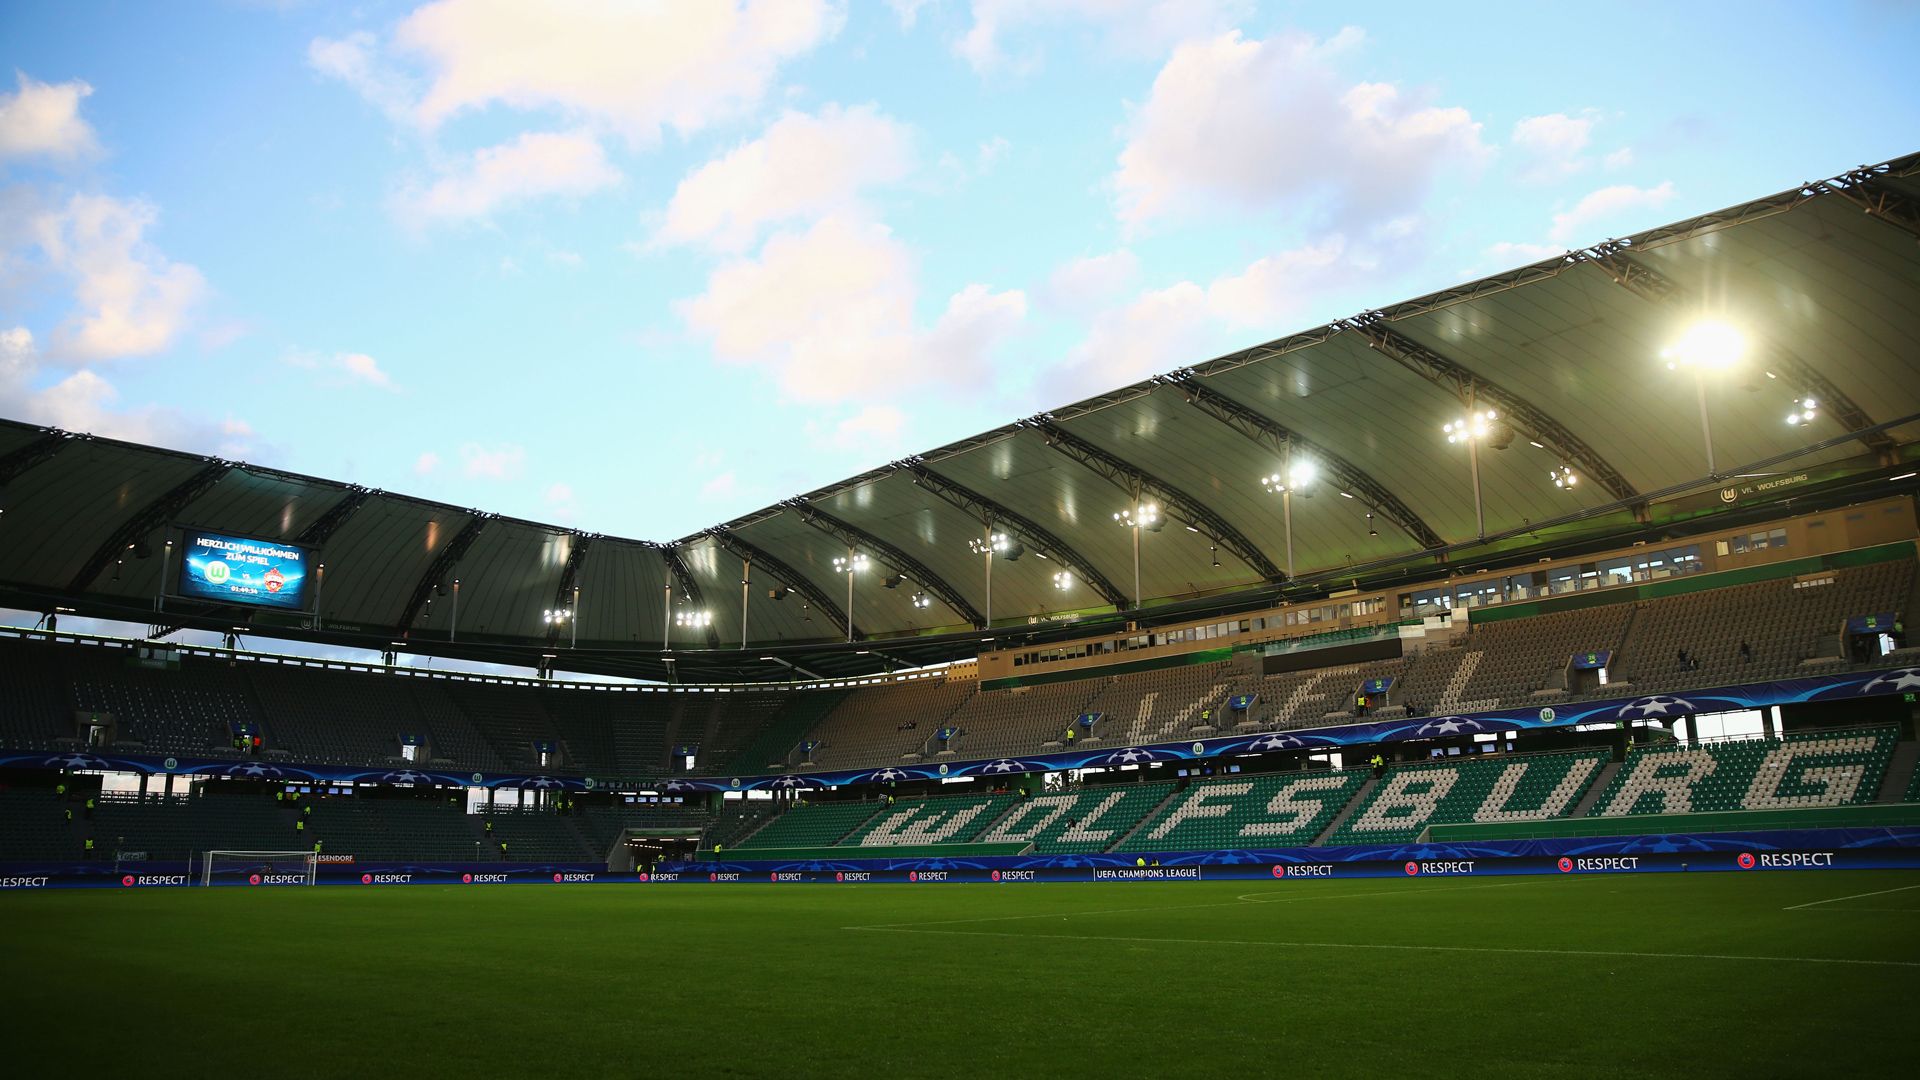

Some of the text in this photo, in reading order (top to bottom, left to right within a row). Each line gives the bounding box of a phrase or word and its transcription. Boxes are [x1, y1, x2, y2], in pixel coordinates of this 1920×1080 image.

[1756, 474, 1808, 491] WOLFSBURG
[197, 538, 299, 561] HERZLICH WILLKOMMEN
[226, 552, 270, 566] ZUM SPIEL
[1050, 613, 1079, 622] WOLFSBURG
[1577, 857, 1639, 870] RESPECT
[1760, 852, 1834, 867] RESPECT
[1287, 865, 1333, 876] RESPECT
[1422, 861, 1475, 874] RESPECT
[374, 874, 412, 883] RESPECT
[473, 874, 508, 883] RESPECT
[563, 873, 595, 882] RESPECT
[650, 873, 679, 881] RESPECT
[717, 873, 740, 881] RESPECT
[778, 872, 802, 881] RESPECT
[844, 872, 871, 881] RESPECT
[918, 871, 948, 881] RESPECT
[1002, 870, 1035, 880] RESPECT
[1096, 868, 1197, 879] UEFA CHAMPIONS LEAGUE
[138, 875, 186, 885] RESPECT
[263, 875, 305, 884] RESPECT
